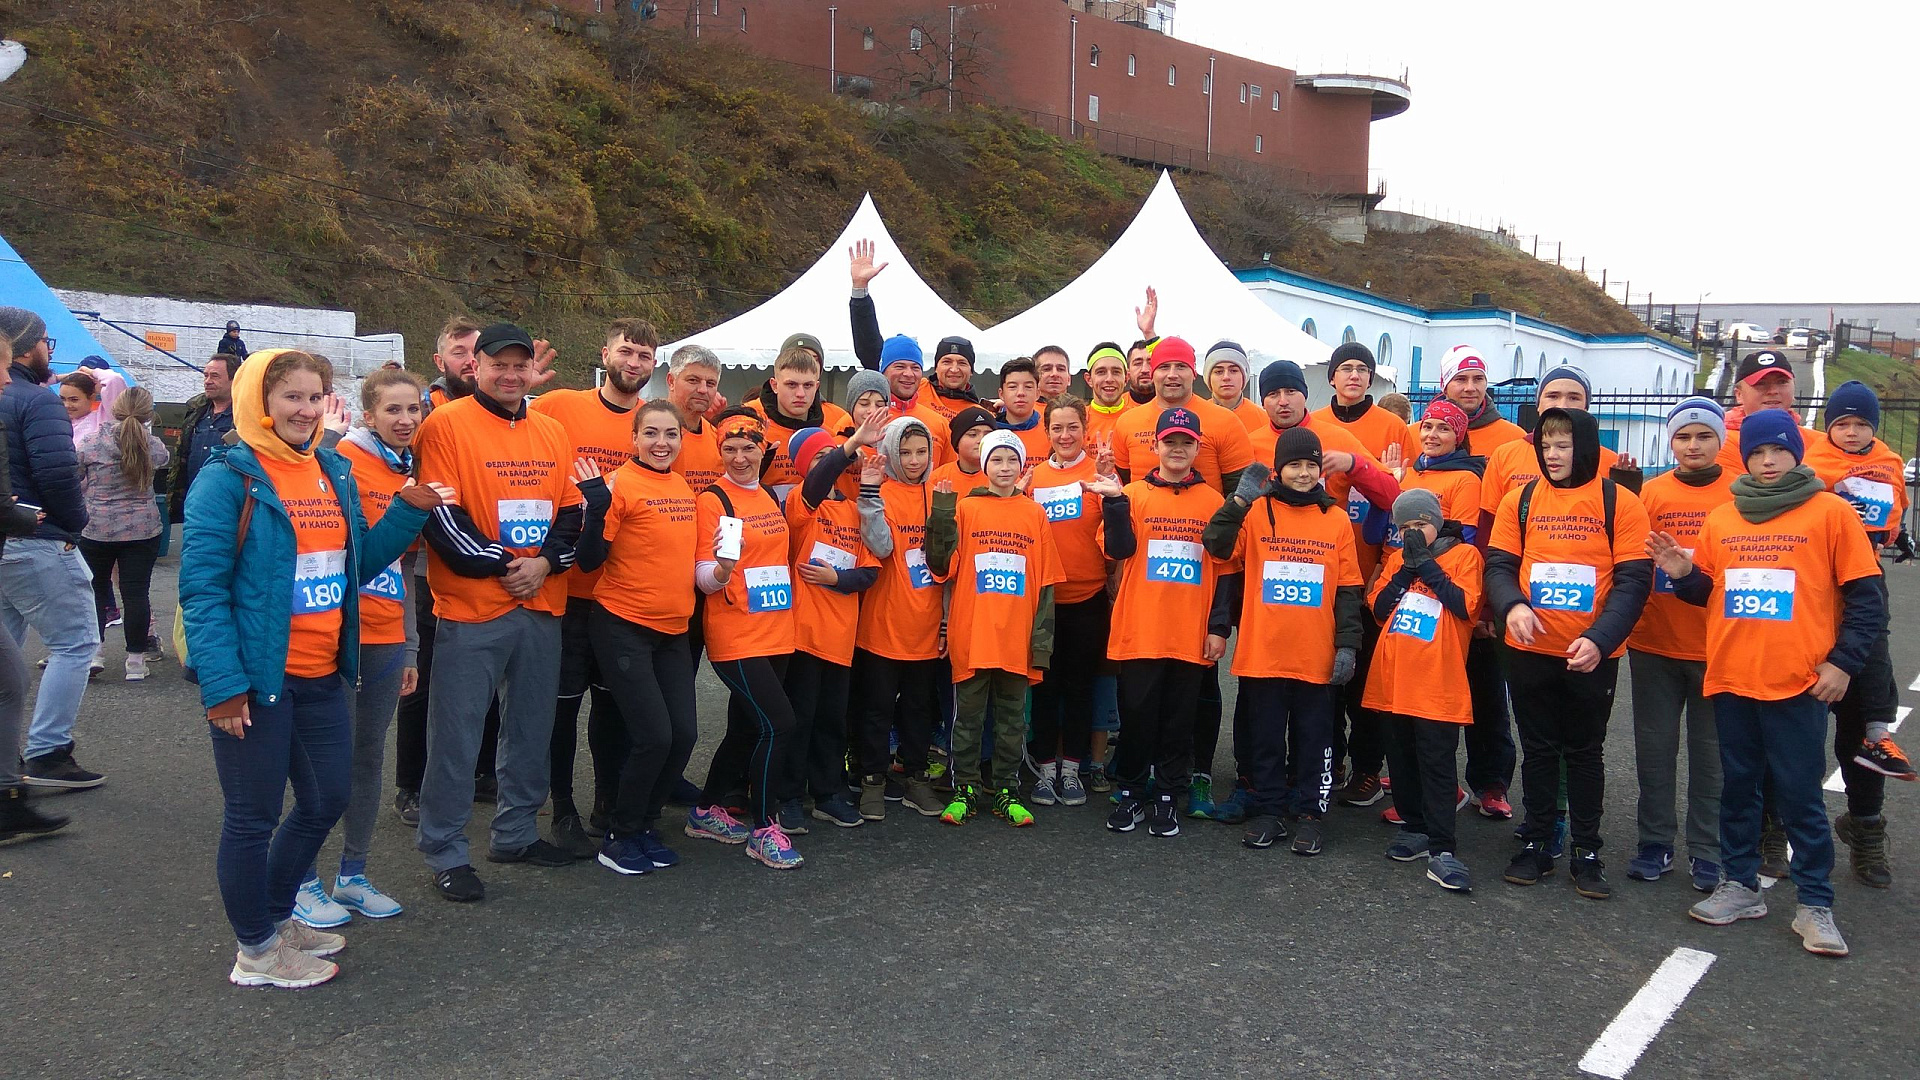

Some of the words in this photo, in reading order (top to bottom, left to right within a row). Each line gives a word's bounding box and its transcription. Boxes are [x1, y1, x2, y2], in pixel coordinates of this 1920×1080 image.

[147, 335, 175, 343] ВЫХОДА
[577, 446, 622, 458] ФЕДЕРАЦИЯ
[486, 460, 530, 468] ФЕДЕРАЦИЯ
[497, 470, 508, 478] НА
[685, 470, 710, 478] ДЕРАЦИЯ
[368, 490, 392, 500] ФЕДЕР
[1046, 502, 1077, 519] 498
[300, 521, 307, 529] И
[309, 520, 340, 529] КАНОЭ
[1144, 516, 1187, 525] ФЕДЕРАЦИЯ
[823, 527, 833, 535] НА
[972, 530, 1012, 538] ФЕДЕРАЦИЯ
[1551, 524, 1600, 534] БАЙДАРКАХ
[909, 536, 925, 545] КРА
[1169, 533, 1194, 542] КАНОЭ
[1558, 533, 1587, 541] КАНОЭ
[1721, 534, 1770, 545] ФЕДЕРАЦИЯ
[1773, 534, 1808, 544] ГРЕБЛИ
[979, 538, 989, 546] НА
[989, 537, 1028, 550] БАЙДАРКАХ
[1260, 536, 1306, 546] ФЕДЕРАЦИЯ
[1308, 538, 1336, 550] ГРЕБЛИ
[1740, 543, 1794, 552] БАЙДАРКАХ
[1281, 544, 1325, 557] БАЙДАРКАХ
[1279, 554, 1286, 562] И
[1287, 554, 1314, 564] КАНОЭ
[1747, 554, 1779, 562] КАНОЭ
[1156, 561, 1195, 580] 470
[984, 573, 1017, 591] 396
[302, 581, 342, 608] 180
[760, 589, 788, 608] 110
[1273, 584, 1312, 603] 393
[1540, 587, 1582, 607] 252
[1732, 595, 1779, 615] 394
[1392, 613, 1422, 634] 251
[1318, 746, 1333, 813] adidas
